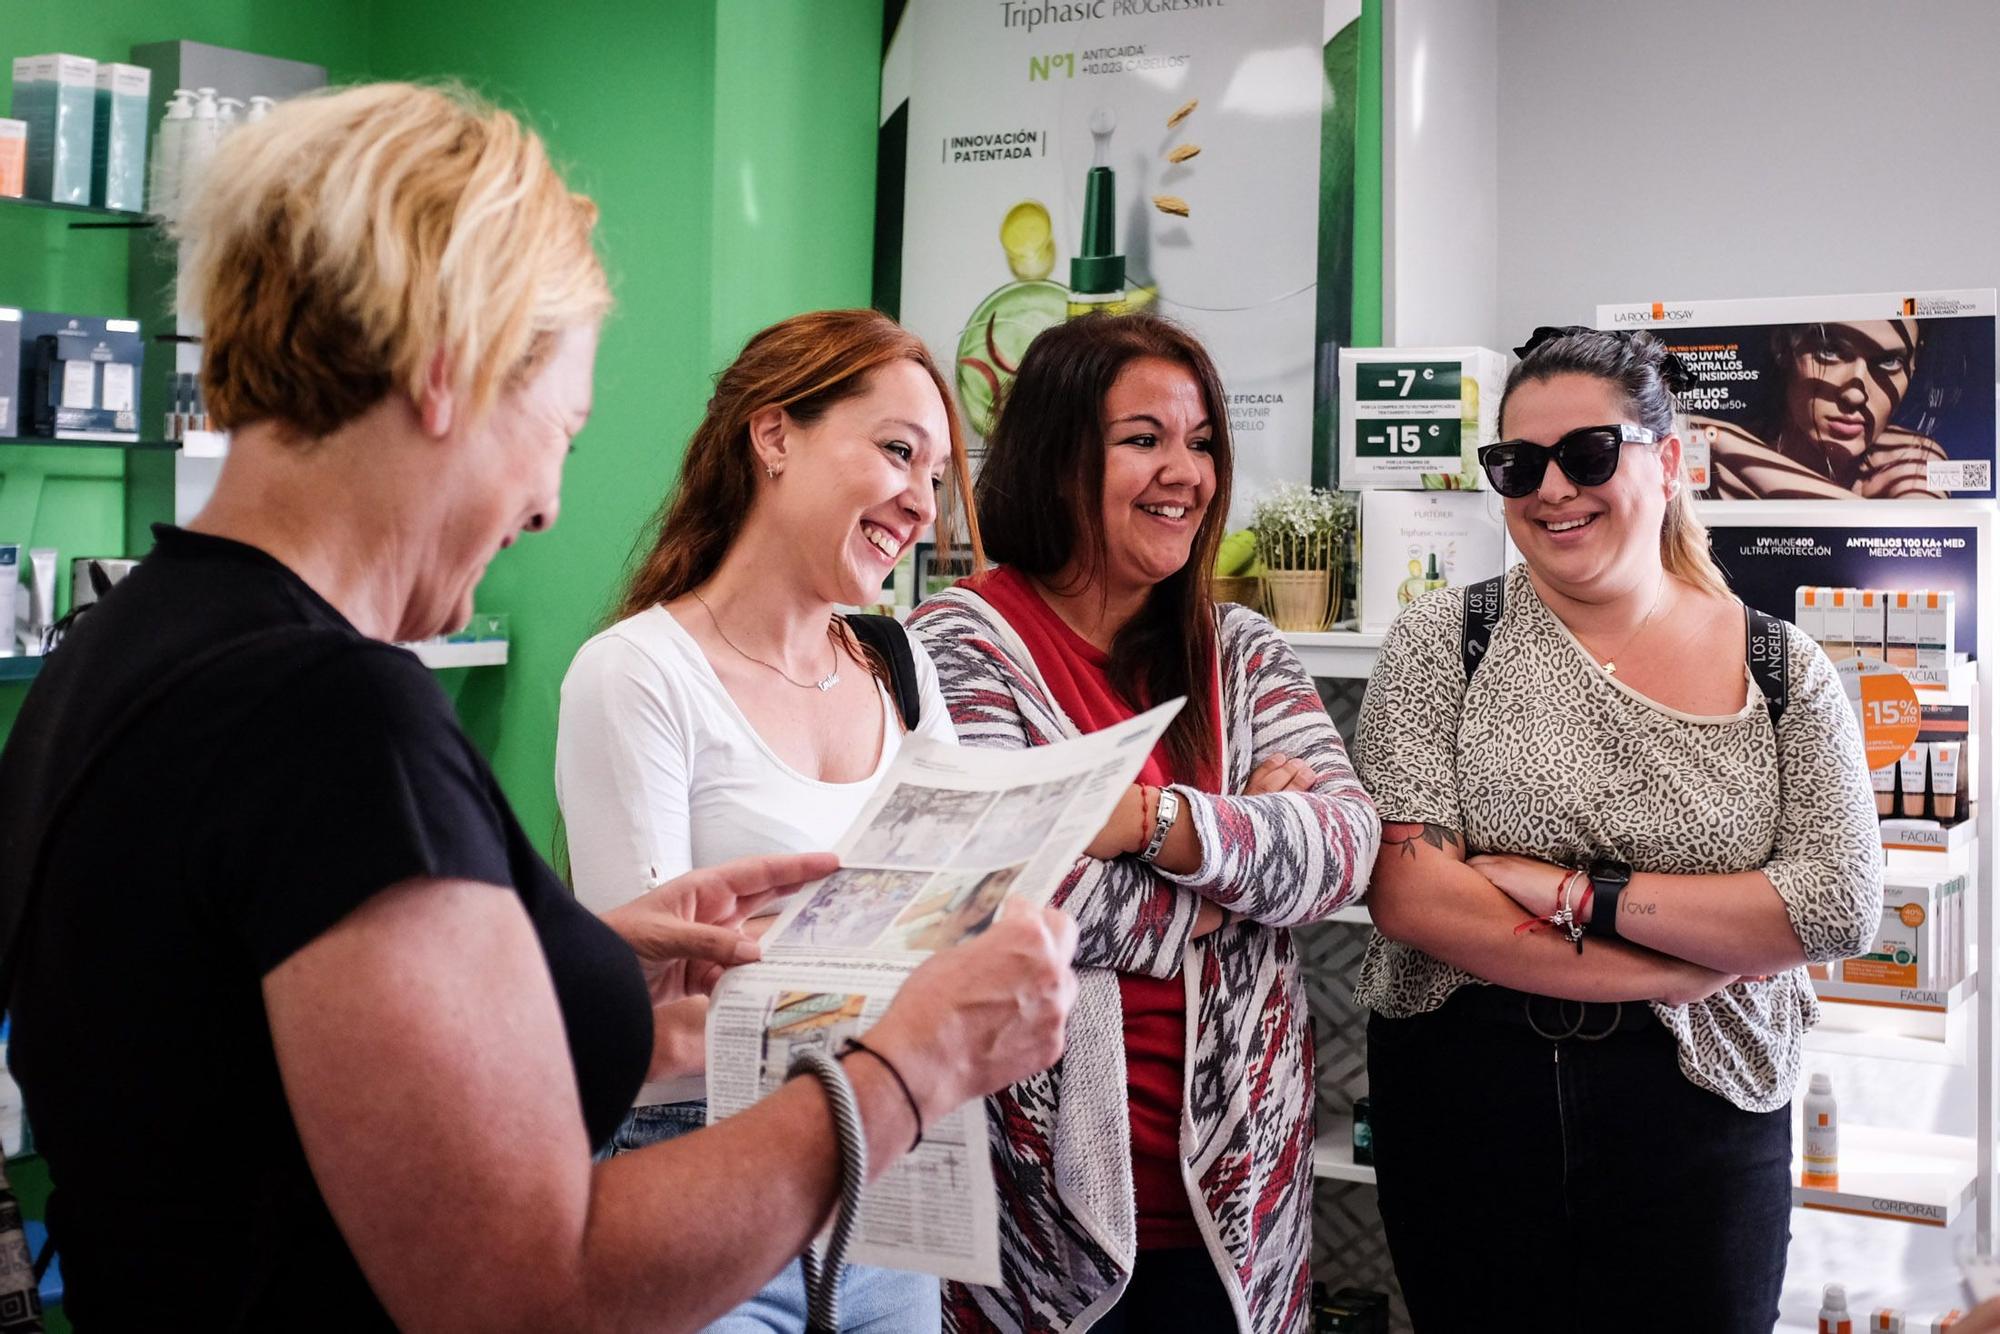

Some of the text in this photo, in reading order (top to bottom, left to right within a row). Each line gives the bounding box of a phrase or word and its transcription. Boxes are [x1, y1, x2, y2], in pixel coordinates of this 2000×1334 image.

[1000, 0, 1104, 33] Triphasic
[951, 129, 1037, 149] INNOVACIÓN
[954, 147, 1033, 163] PATENTADA
[1904, 298, 1916, 316] 1
[1663, 310, 1694, 320] POSAY
[1677, 349, 1736, 362] TRO UV MÁS
[1687, 361, 1742, 372] ONTRA LOS
[1234, 394, 1284, 404] EFICACIA
[1677, 388, 1729, 400] THELIOS
[1231, 408, 1270, 418] REVENIR
[1229, 421, 1265, 431] ABELLO
[1367, 425, 1421, 454] -15
[1757, 537, 1815, 547] UVMUNE400
[1846, 537, 1966, 549] ANTHELIOS 100 KA+ MED
[1740, 545, 1832, 556] ULTRA PROTECCIÓN
[1868, 548, 1943, 558] MEDICAL DEVICE
[1469, 593, 1483, 615] LOS
[1483, 581, 1499, 633] ANGELES
[1752, 635, 1767, 662] LOS
[1768, 622, 1783, 683] ANGELES
[1900, 715, 1917, 725] DTO
[1901, 831, 1942, 844] FACIAL
[1900, 989, 1942, 1004] FACIAL
[1872, 1198, 1941, 1219] CORPORAL
